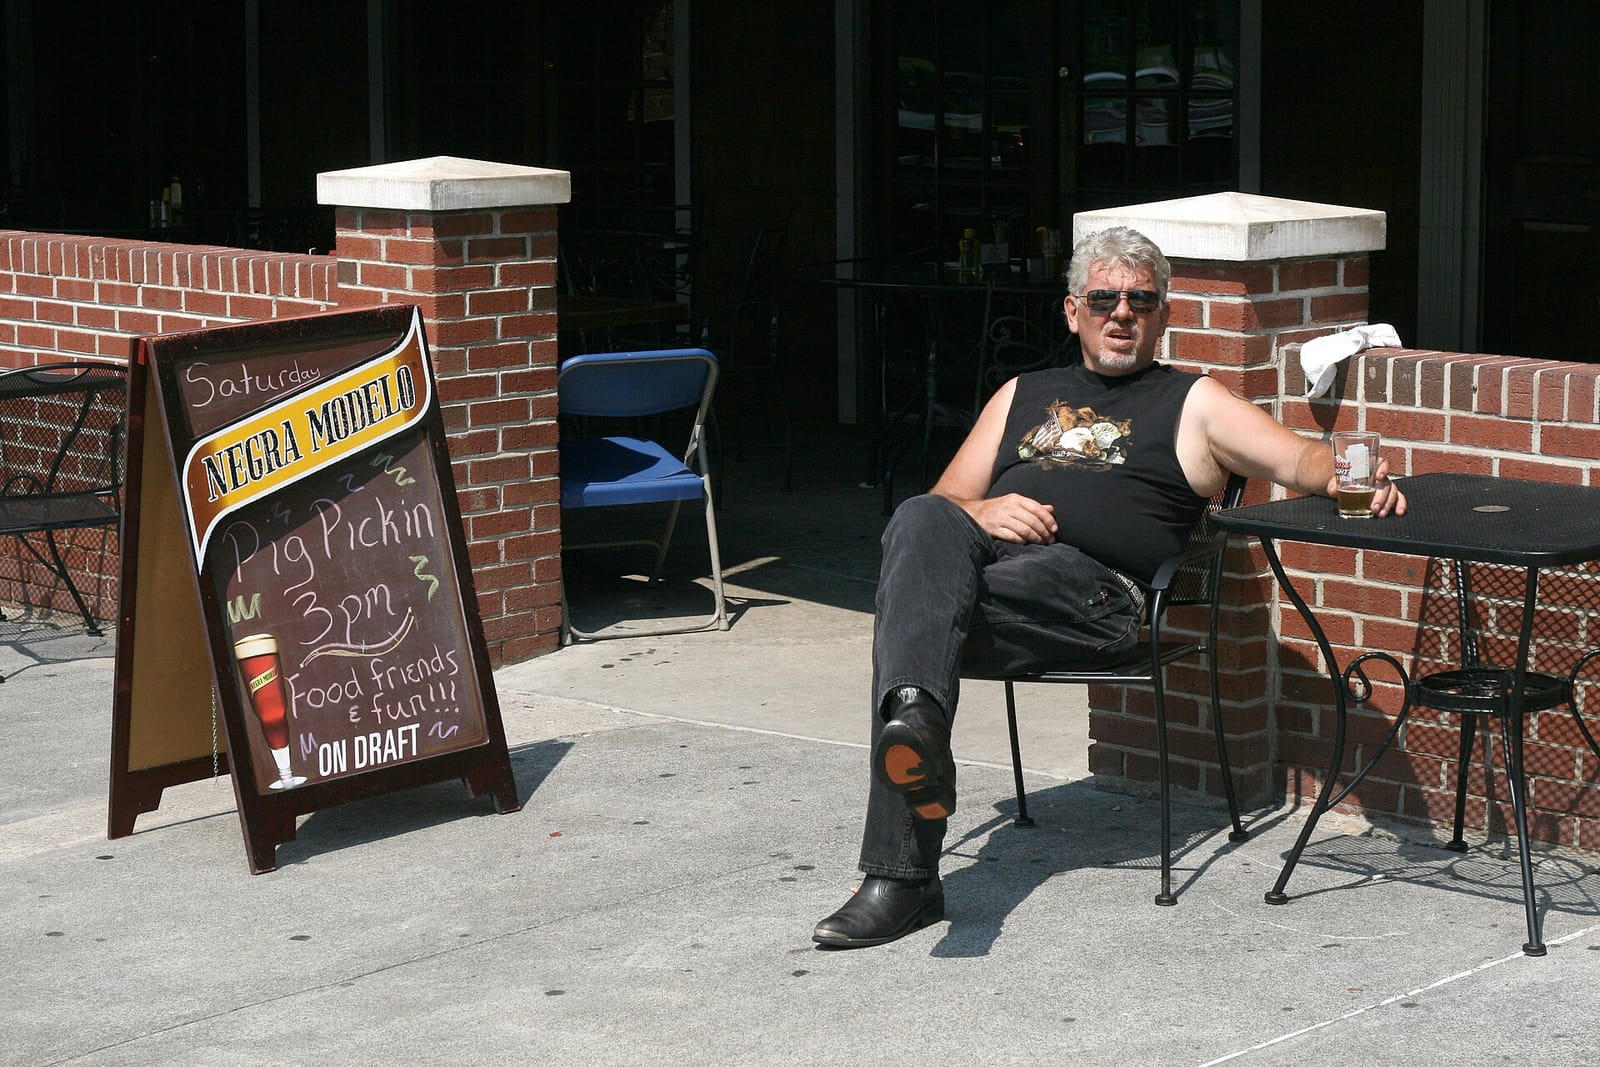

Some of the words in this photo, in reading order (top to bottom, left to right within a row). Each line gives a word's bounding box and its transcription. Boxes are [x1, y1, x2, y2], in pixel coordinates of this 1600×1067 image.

[185, 360, 321, 407] Saturday
[201, 420, 303, 502] NEGRA
[305, 364, 416, 452] MODELO
[223, 520, 315, 596] Pig
[309, 496, 434, 559] Pickin
[284, 667, 363, 718] Food
[370, 643, 459, 691] friends
[318, 736, 347, 776] ON
[354, 723, 420, 769] DRAFT
